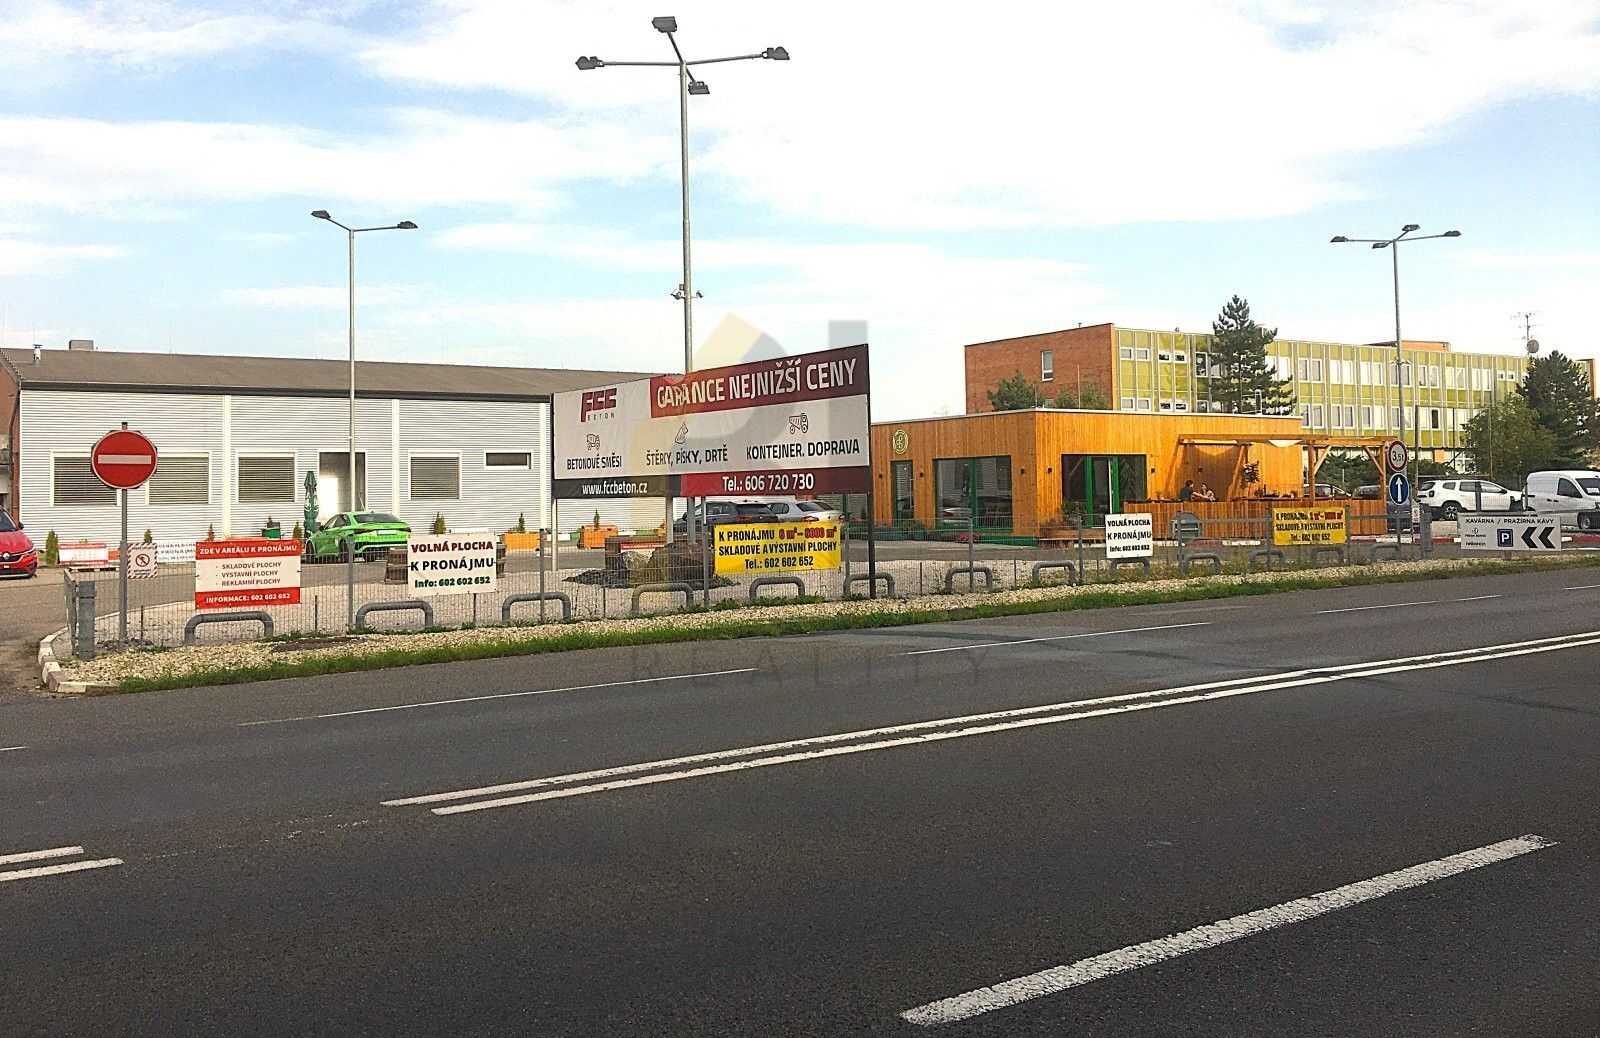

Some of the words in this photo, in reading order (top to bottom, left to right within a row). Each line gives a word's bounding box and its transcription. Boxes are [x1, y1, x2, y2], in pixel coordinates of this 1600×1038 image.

[729, 357, 802, 400] NEJNIŽŠÍ
[806, 357, 857, 390] CENY
[587, 412, 615, 421] BETON
[676, 448, 702, 465] PÍSKY,
[705, 443, 728, 463] DRTĚ
[746, 442, 805, 464] KONTEJNER.
[807, 438, 860, 457] DOPRAVA
[567, 453, 600, 471] BETONOVÉ
[601, 452, 622, 469] SMĚSI
[582, 480, 648, 496] www.fccbeton.cz
[722, 475, 743, 493] Tel.:
[744, 475, 765, 492] 606
[767, 474, 790, 491] 720
[791, 472, 815, 490] 730
[719, 531, 725, 542] K
[727, 528, 774, 541] PRONÁJMU
[1114, 530, 1151, 540] PRONÁJMU
[1501, 533, 1510, 543] P
[221, 545, 249, 554] AREÁLU
[258, 544, 297, 552] PRONÁJMU
[411, 541, 450, 553] VOLNÁ
[451, 541, 493, 551] PLOCHA
[719, 543, 760, 555] SKLADOVÉ
[769, 540, 806, 553] VÝSTAVNÍ
[808, 541, 837, 551] PLOCHY
[411, 562, 419, 571] K
[423, 556, 494, 571] PRONÁJMU
[745, 558, 763, 569] Tel.:
[764, 557, 780, 568] 602
[782, 557, 797, 567] 602
[799, 556, 813, 566] 652
[222, 579, 255, 587] REKLAMNÍ
[415, 580, 437, 588] Info:
[456, 577, 473, 586] 602
[206, 595, 250, 603] INFORMACE:
